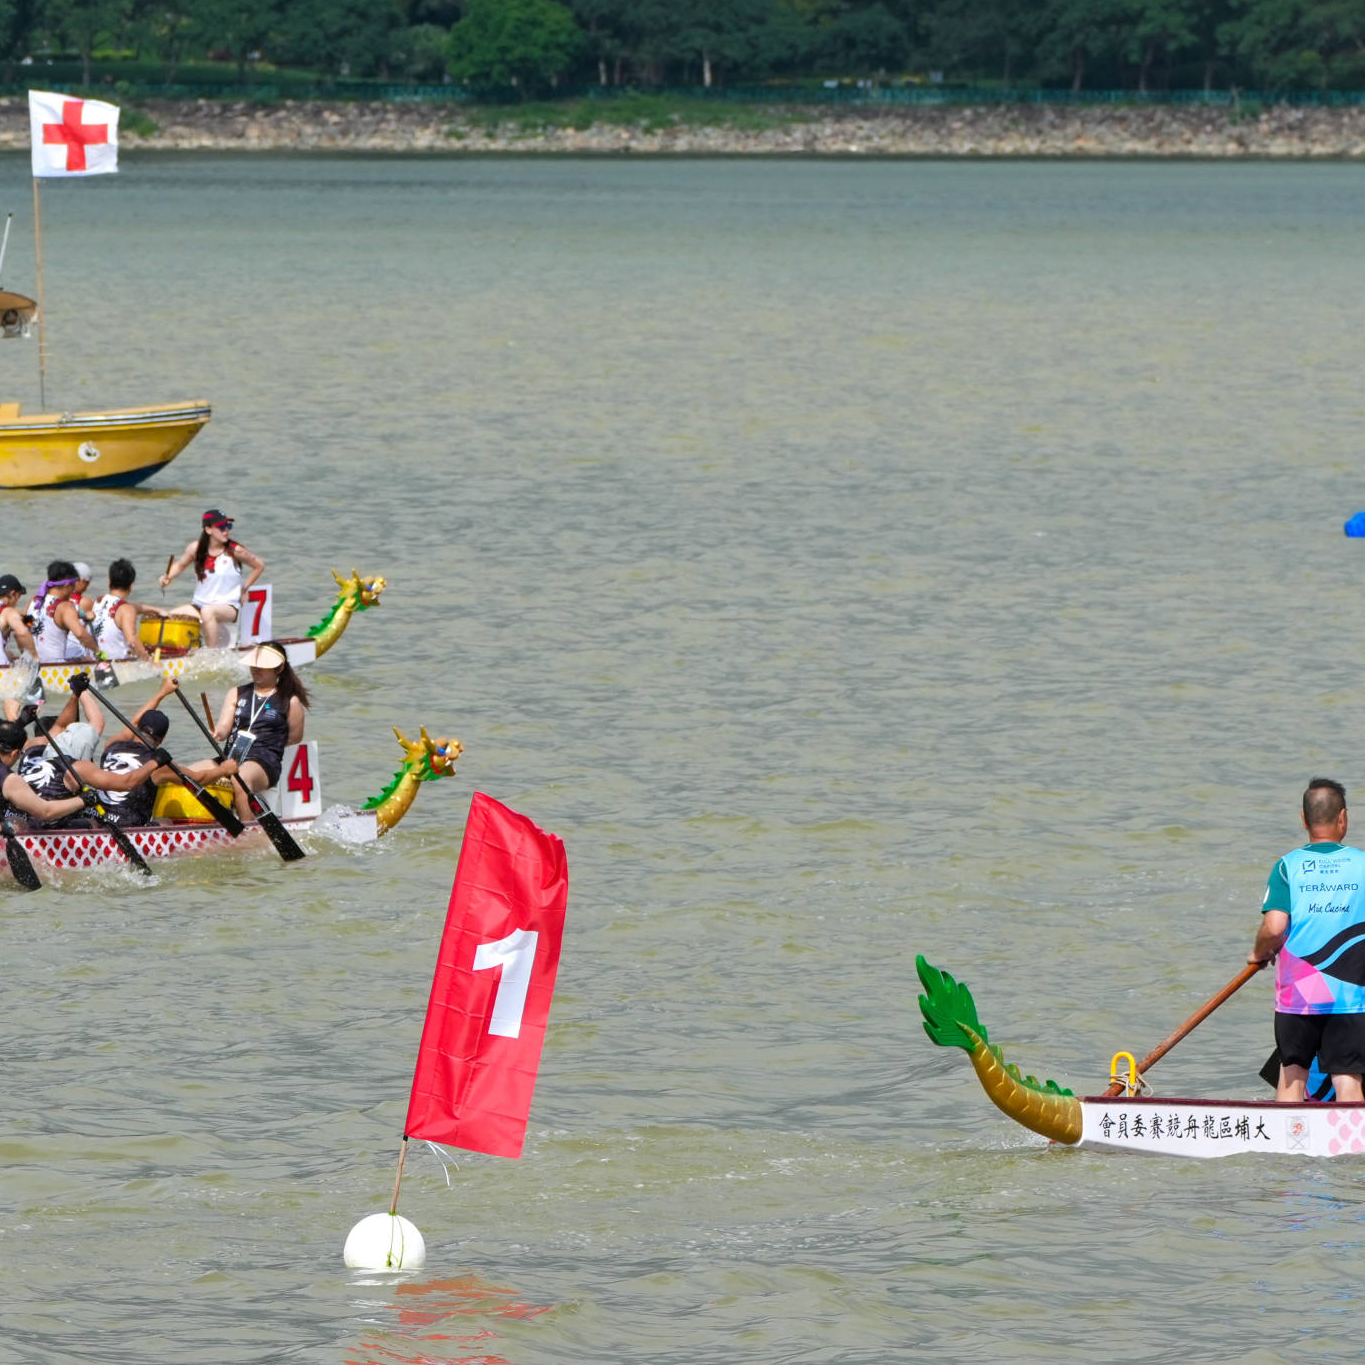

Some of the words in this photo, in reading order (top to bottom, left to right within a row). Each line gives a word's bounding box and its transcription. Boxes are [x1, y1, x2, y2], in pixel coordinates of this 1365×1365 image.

[248, 589, 267, 636] 7
[288, 744, 314, 803] 4
[472, 927, 539, 1038] 1
